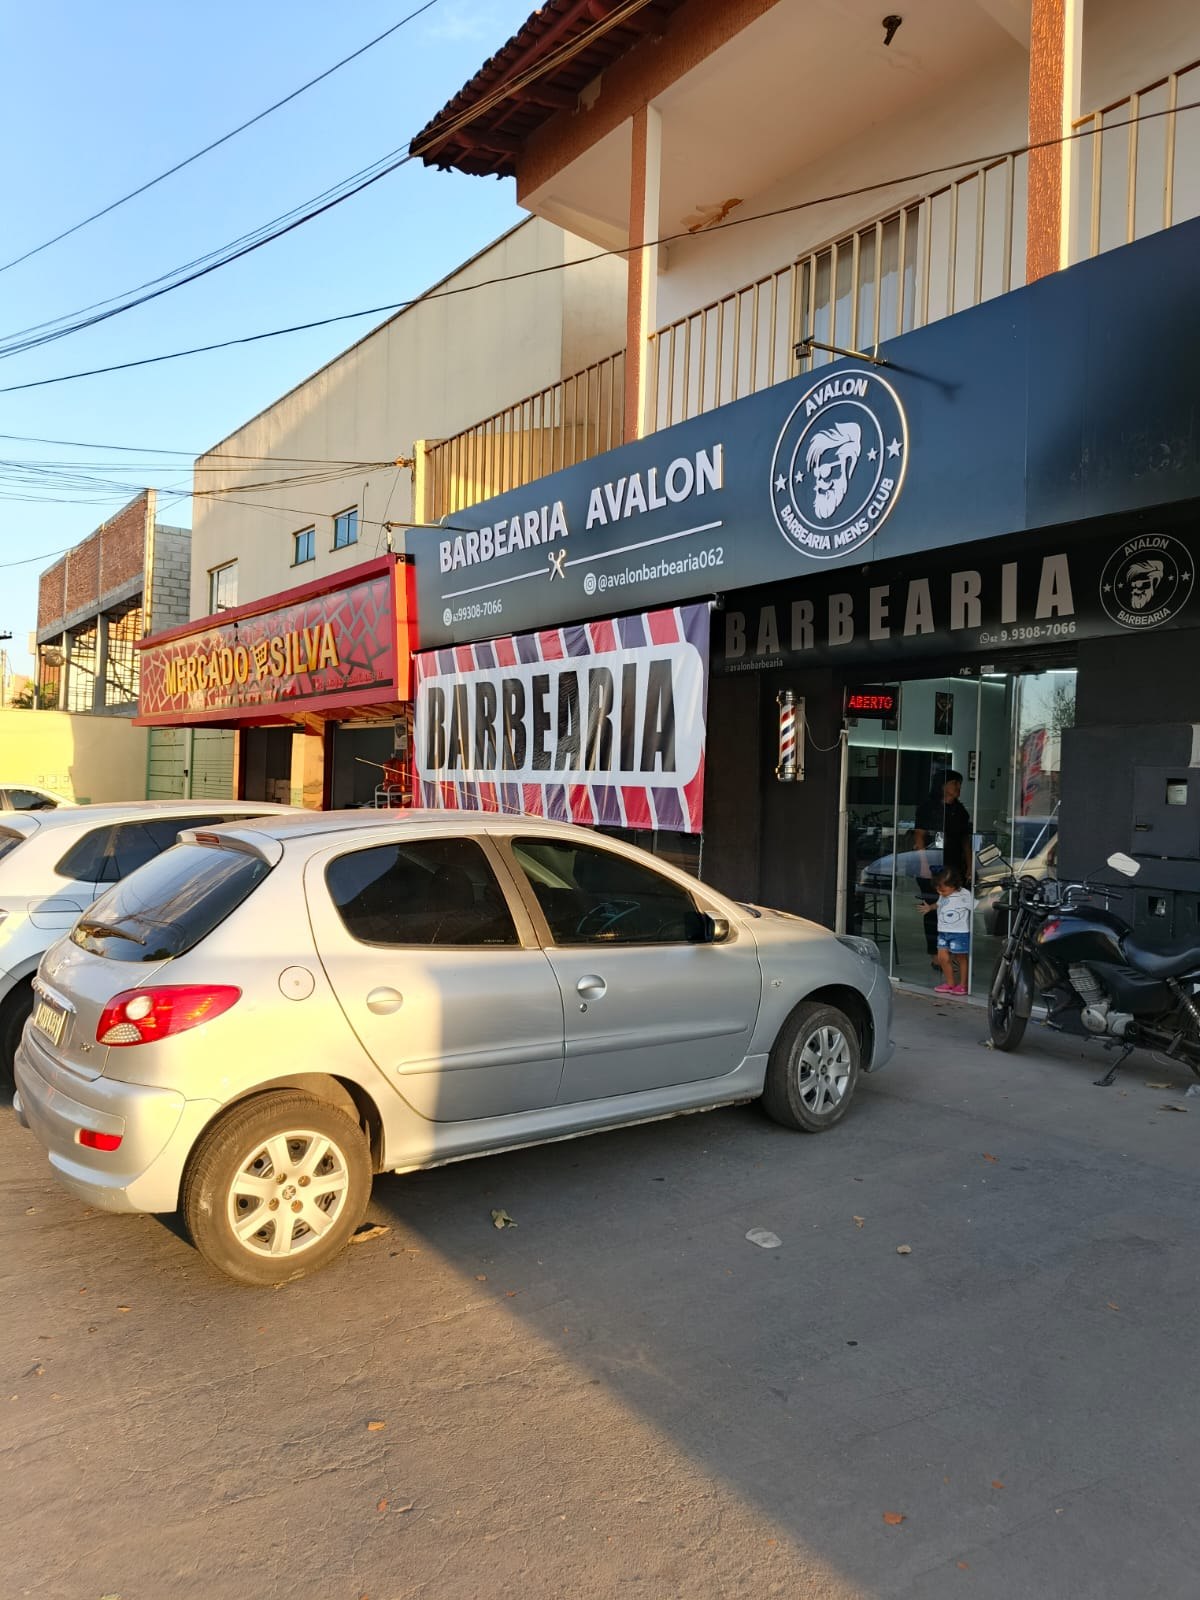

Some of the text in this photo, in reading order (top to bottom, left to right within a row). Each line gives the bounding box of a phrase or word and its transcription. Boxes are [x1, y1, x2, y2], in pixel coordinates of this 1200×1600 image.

[804, 378, 868, 416] AVALON
[440, 443, 723, 573] BARBEARIA AVALON
[780, 477, 894, 550] BARBEARIA MENS CLUB
[598, 547, 724, 591] @avalonbarbearia062
[1124, 537, 1169, 557] AVALON
[725, 553, 1075, 659] BARBEARIA
[1117, 607, 1171, 625] BARBEARIA
[1000, 621, 1076, 641] 9.9308-7066
[165, 622, 340, 696] MERCADO SILVA
[426, 658, 677, 773] BARBEARIA
[848, 695, 894, 709] ABERTO
